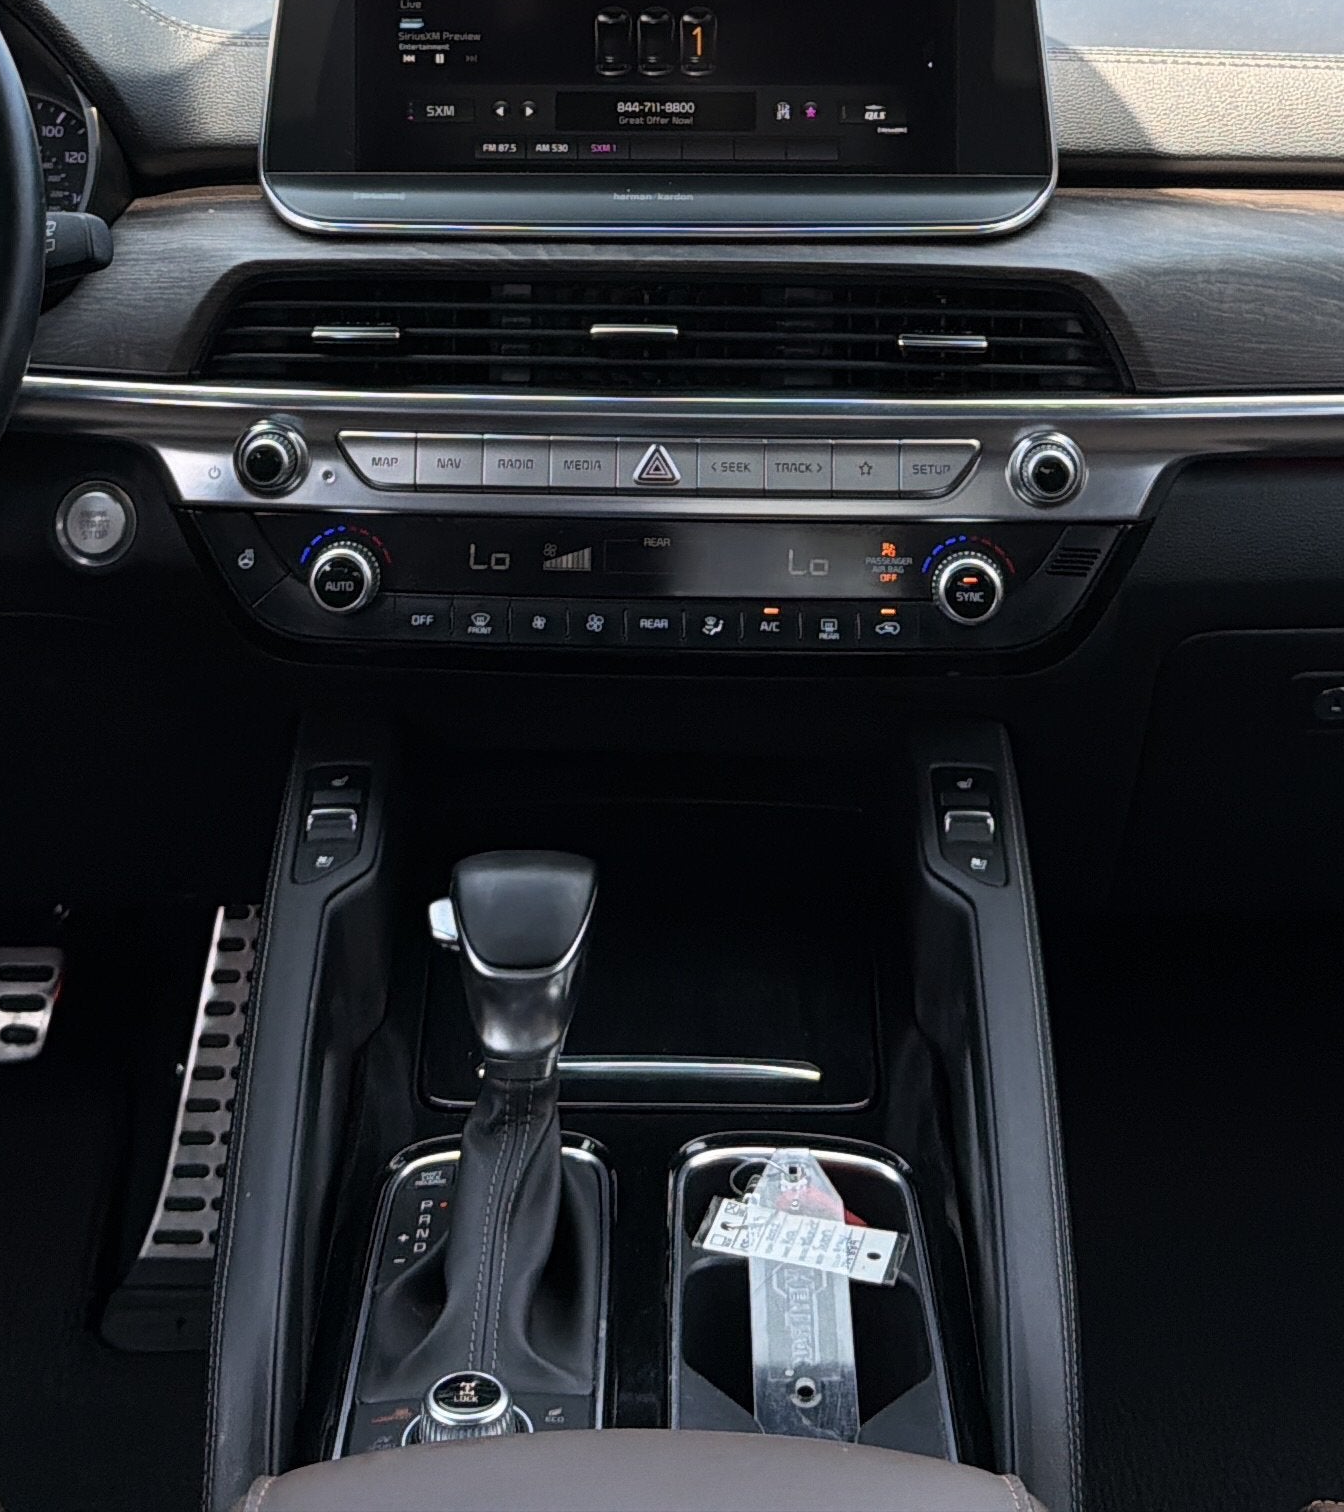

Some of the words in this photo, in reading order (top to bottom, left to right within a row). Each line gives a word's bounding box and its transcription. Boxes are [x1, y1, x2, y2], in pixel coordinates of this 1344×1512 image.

[400, 0, 422, 9] Live
[398, 31, 441, 41] SiriusXM
[442, 31, 481, 41] Preview
[691, 26, 703, 57] 1
[426, 105, 455, 117] SXM
[616, 102, 695, 114] 844-711-8800
[618, 115, 645, 125] Great
[646, 115, 670, 125] Offer
[41, 126, 64, 138] 100
[482, 144, 496, 153] FM
[498, 144, 517, 153] 87.5
[535, 144, 550, 153] AM
[551, 144, 569, 153] 530
[64, 151, 87, 164] 120
[371, 456, 399, 467] MAP
[436, 458, 462, 468] NAV
[497, 458, 534, 470] RADIO
[563, 459, 602, 471] MEDIA
[912, 463, 951, 475] SETUP
[643, 536, 672, 548] REAR
[865, 556, 913, 566] PASSENGER
[879, 574, 898, 582] OFF
[325, 580, 355, 592] AUTO
[956, 591, 985, 603] SYNC
[411, 614, 434, 626] OFF
[640, 618, 669, 629] REAR
[759, 621, 781, 632] A/C
[420, 1199, 434, 1210] P
[416, 1228, 430, 1239] N
[413, 1242, 427, 1253] D
[544, 1415, 565, 1424] ECO
